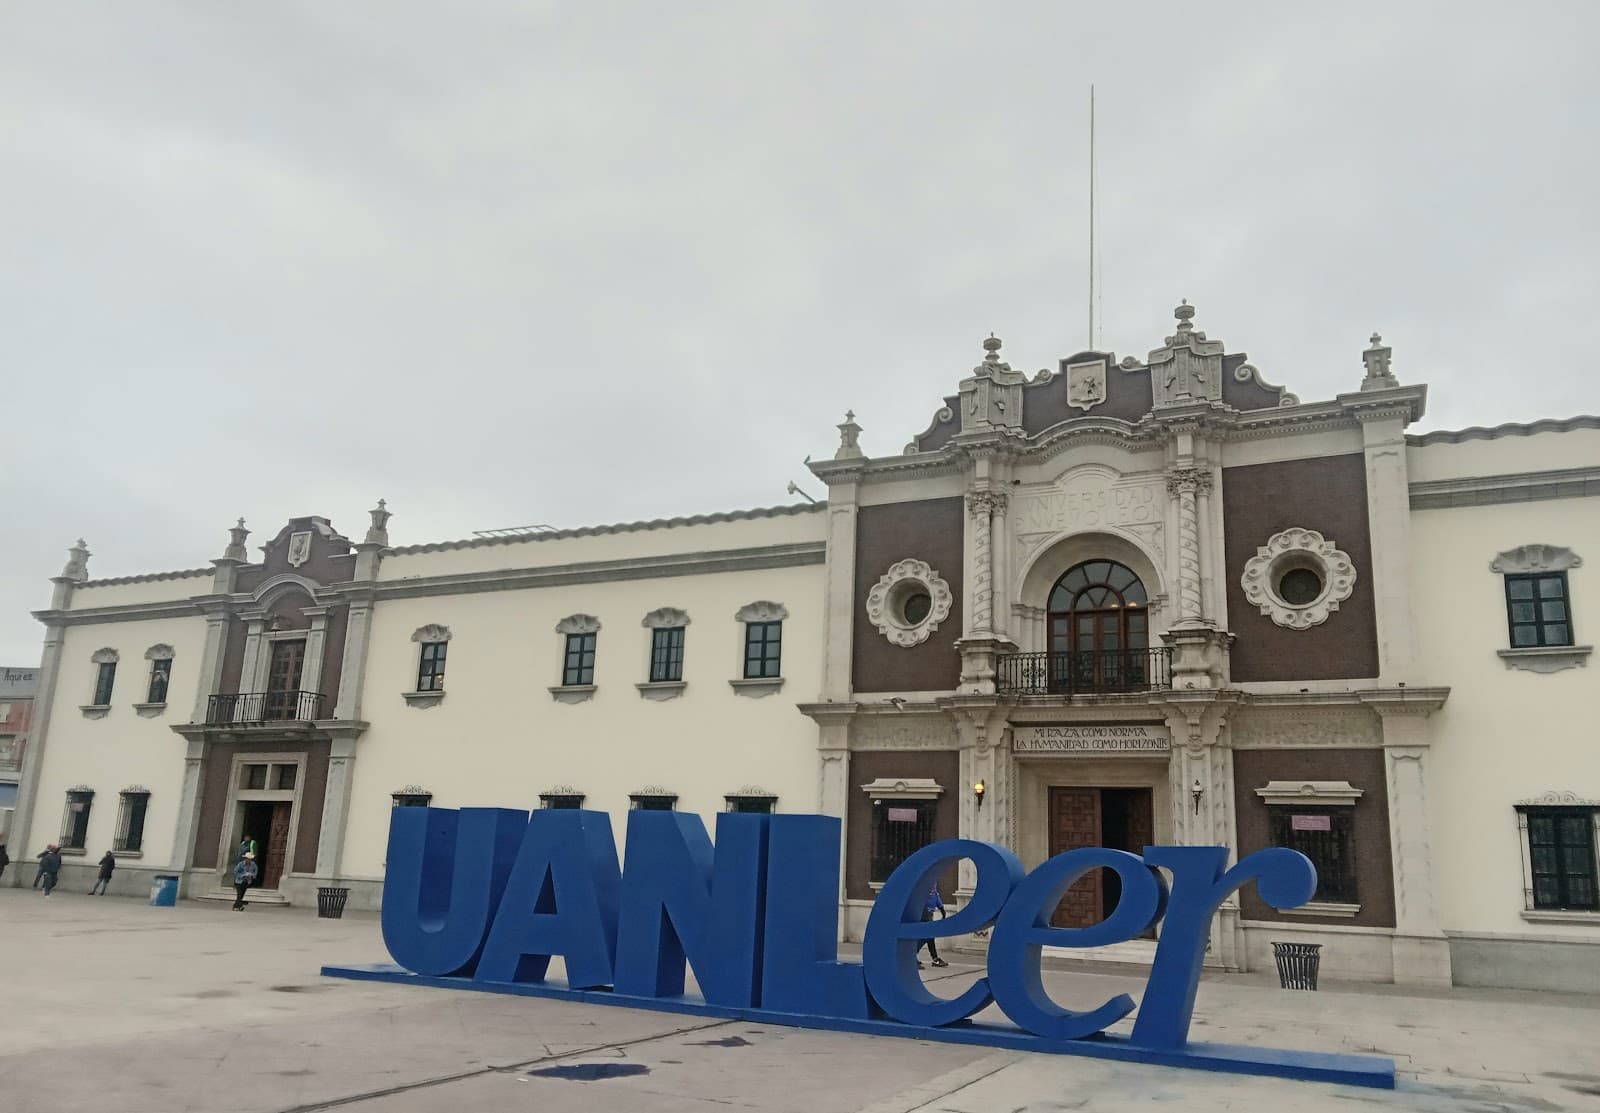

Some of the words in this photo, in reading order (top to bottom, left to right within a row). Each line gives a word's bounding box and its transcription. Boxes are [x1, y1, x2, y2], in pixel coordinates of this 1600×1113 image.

[1047, 727, 1079, 737] RAZA
[1081, 727, 1108, 737] COMO
[1109, 727, 1147, 737] NORMA
[1016, 740, 1027, 749] LA
[1092, 739, 1118, 749] COMO
